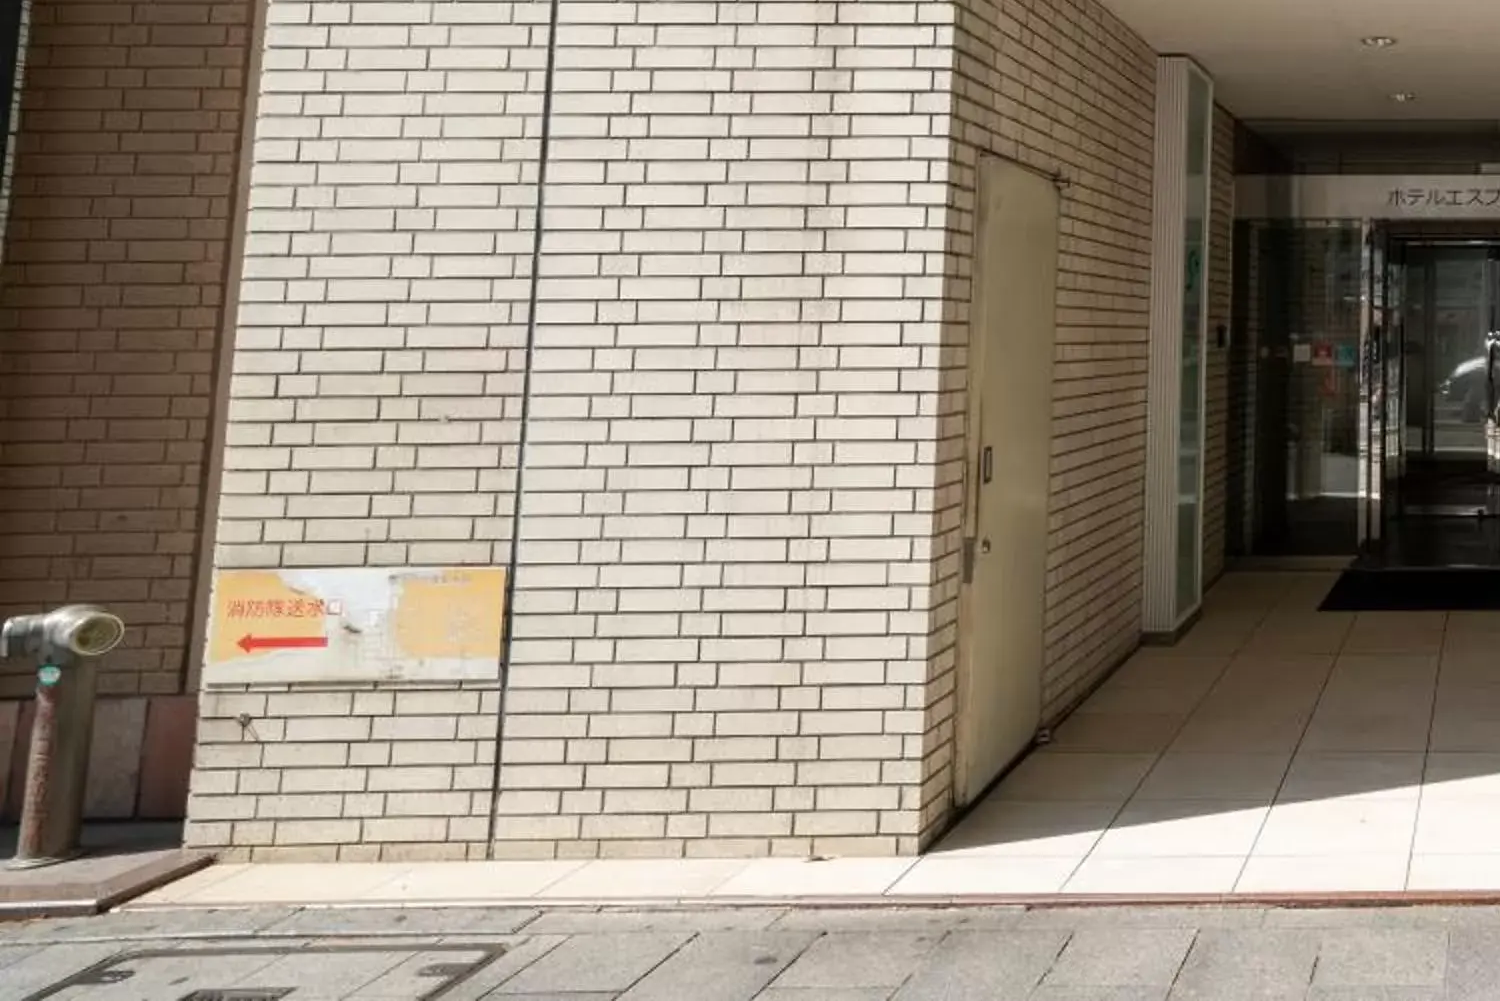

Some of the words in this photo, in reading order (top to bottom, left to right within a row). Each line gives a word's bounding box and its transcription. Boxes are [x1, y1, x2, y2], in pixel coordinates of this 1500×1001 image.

[226, 597, 345, 620] 消防隊送水口
